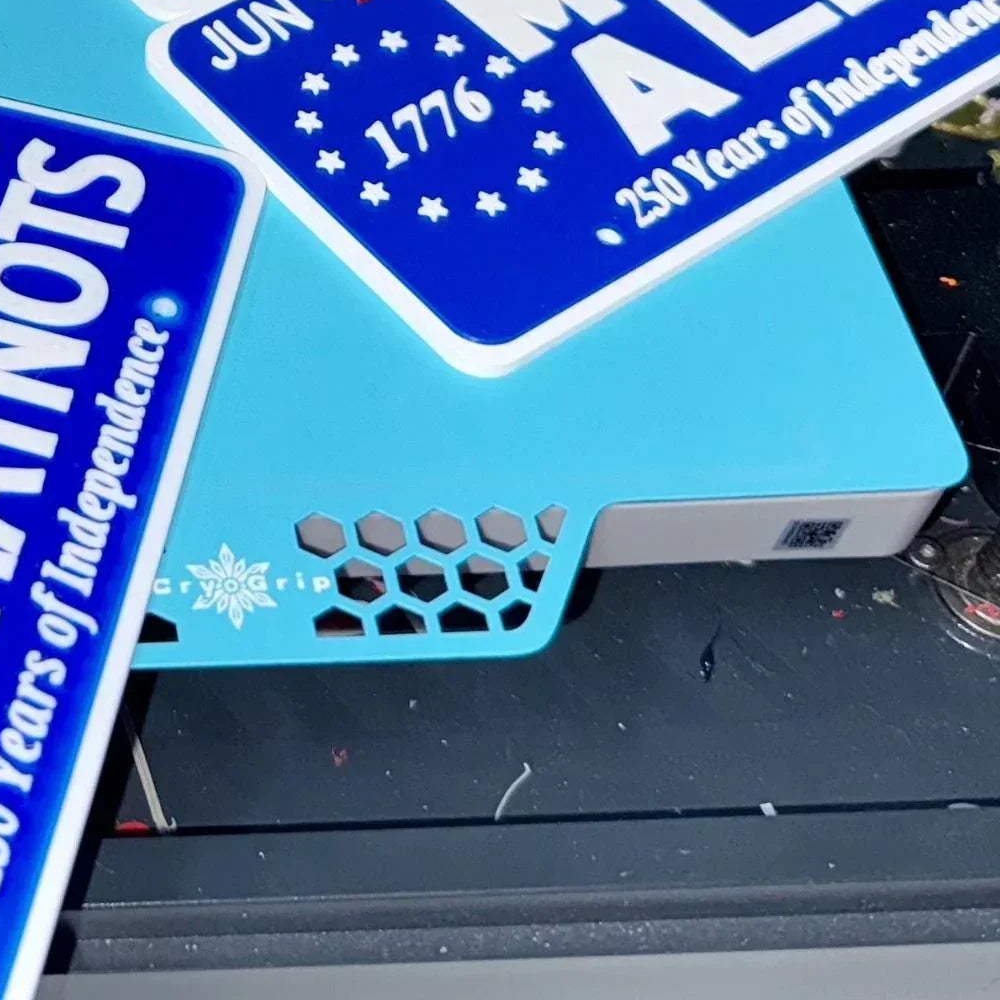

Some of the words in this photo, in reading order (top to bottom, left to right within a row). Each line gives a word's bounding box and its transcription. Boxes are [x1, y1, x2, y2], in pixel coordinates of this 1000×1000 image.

[363, 75, 494, 172] 1776
[614, 167, 691, 229] 250
[672, 118, 790, 192] Years
[780, 86, 833, 139] of
[36, 316, 171, 598] Independence
[29, 580, 99, 652] of
